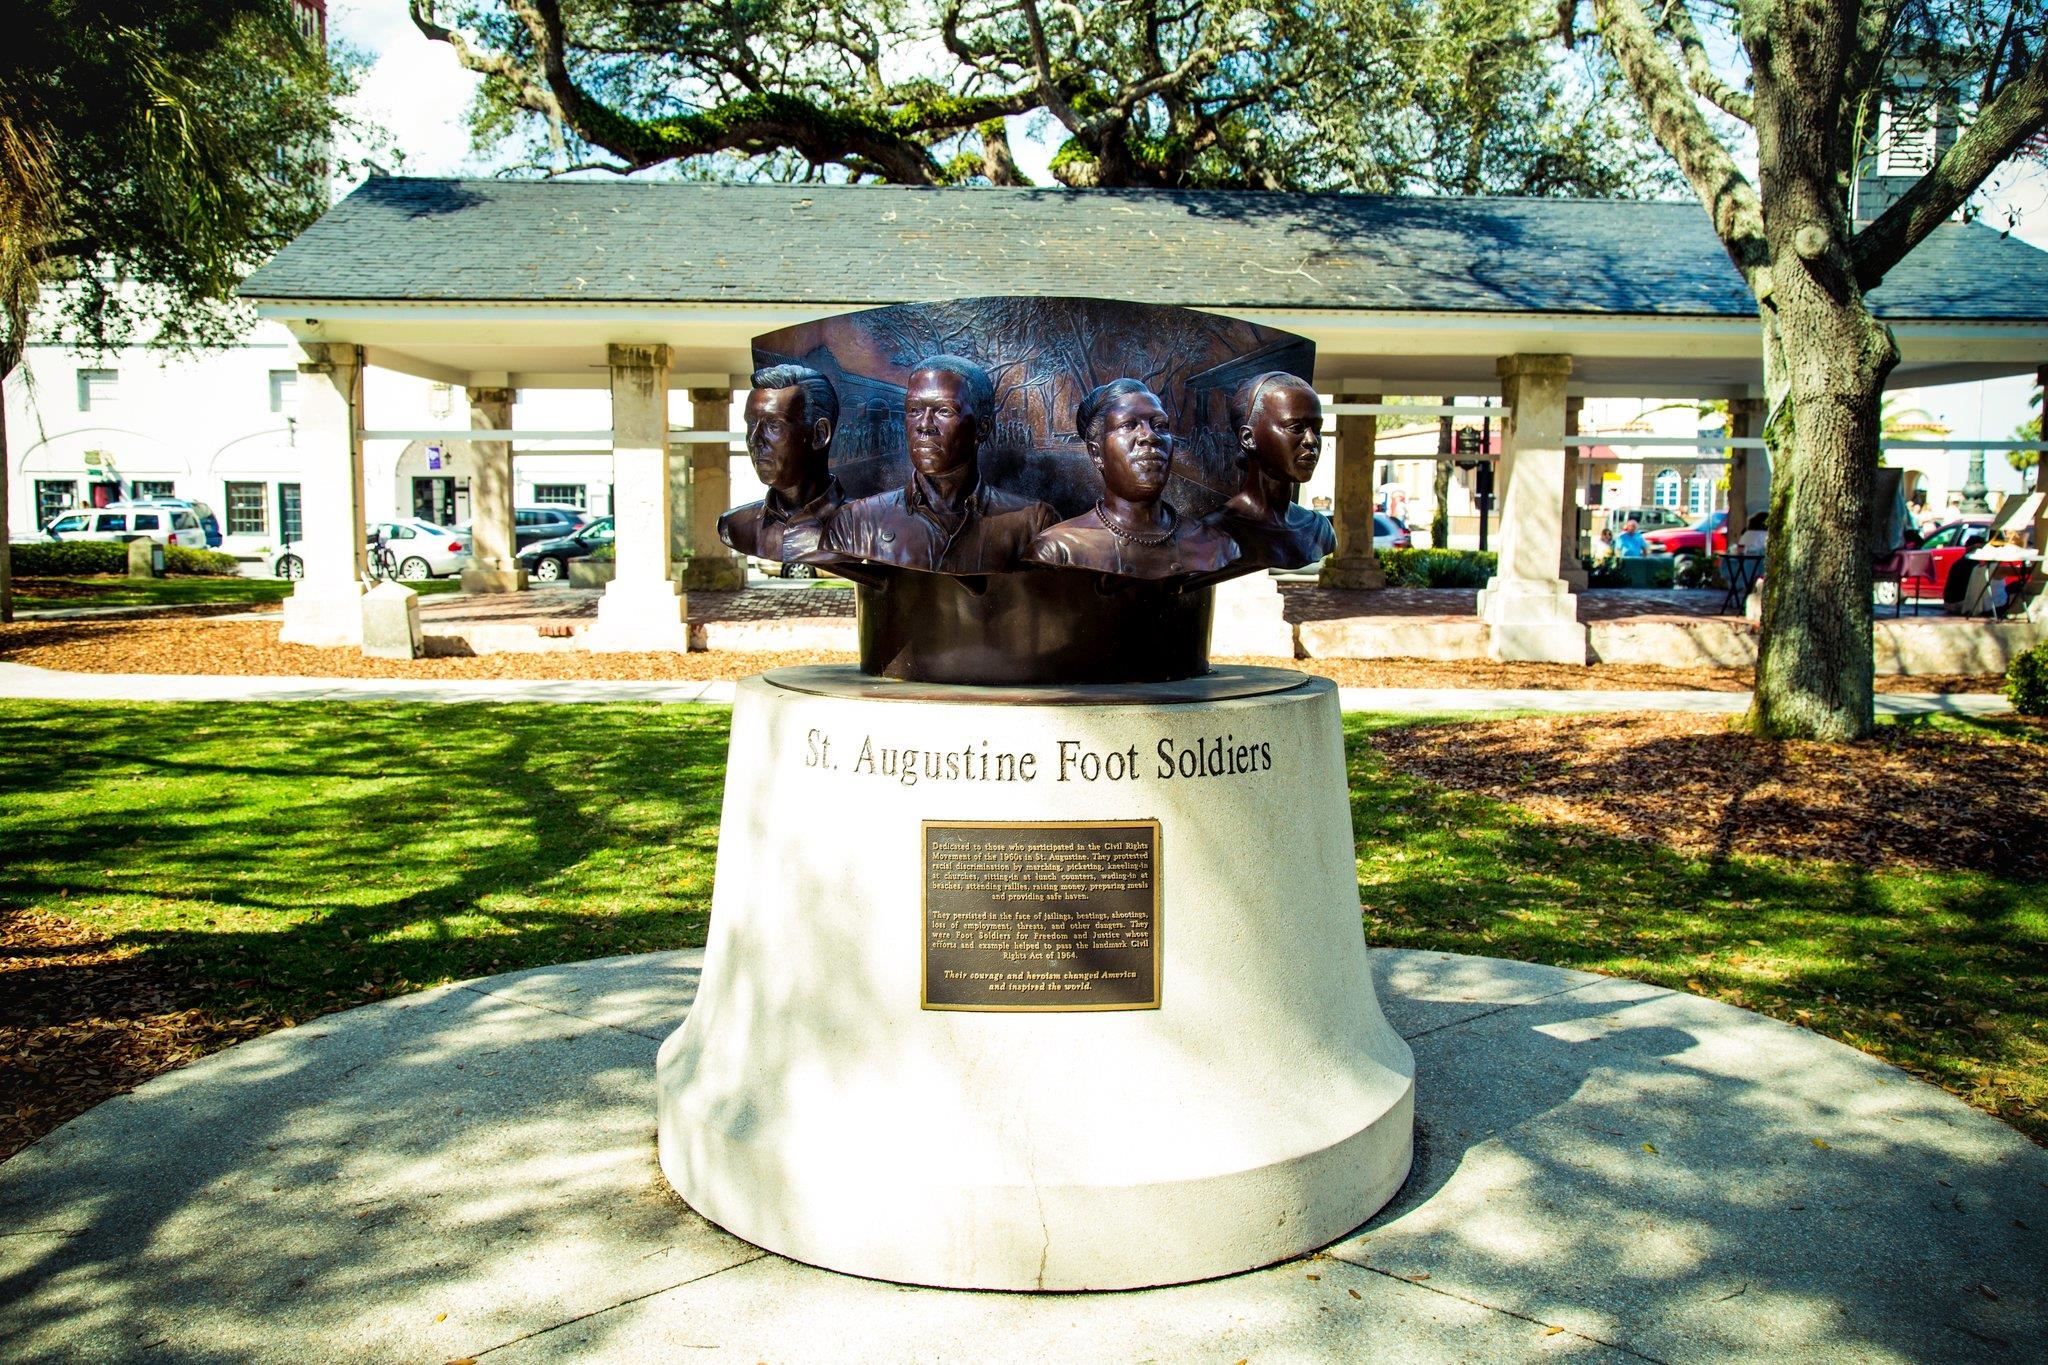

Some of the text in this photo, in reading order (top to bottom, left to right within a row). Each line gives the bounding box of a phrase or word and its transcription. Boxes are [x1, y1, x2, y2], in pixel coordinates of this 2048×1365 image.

[805, 728, 1272, 784] St. Augustine Foot Soldiers
[932, 842, 970, 851] Dedicated
[985, 843, 1005, 851] those
[1009, 843, 1025, 851] who
[1028, 843, 1074, 852] participated
[1125, 842, 1149, 851] Rights
[932, 852, 972, 861] Movement
[974, 853, 983, 861] of
[984, 853, 997, 861] the
[1000, 853, 1023, 861] 1960s
[1035, 853, 1046, 861] St.
[1049, 853, 1089, 862] Augustine.
[1092, 853, 1111, 861] They
[1114, 852, 1149, 861] protested
[932, 862, 1148, 872] racial discrimination by marching, picketing, kneeling-in
[944, 872, 980, 881] churches,
[984, 873, 1019, 882] sitting-in
[1101, 872, 1137, 881] wading-in
[932, 882, 963, 891] beaches,
[966, 882, 1002, 891] attending
[1033, 883, 1059, 891] raising
[1090, 882, 1126, 891] preparing
[1127, 881, 1149, 889] meals
[1008, 893, 1045, 901] providing
[932, 911, 950, 920] They
[953, 912, 987, 921] persisted
[1000, 912, 1012, 920] the
[1015, 912, 1031, 920] face
[1034, 912, 1042, 920] of
[1044, 912, 1074, 921] jailings,
[1112, 911, 1149, 919] shootings,
[932, 921, 946, 929] loss
[964, 922, 1013, 931] employment,
[1017, 922, 1047, 930] threats,
[1052, 922, 1066, 930] and
[1095, 922, 1126, 930] dangers.
[1130, 921, 1149, 929] They
[979, 932, 1011, 940] Soldiers
[1034, 932, 1068, 940] Freedom
[1093, 931, 1120, 939] Justice
[1125, 930, 1149, 938] whose
[961, 941, 975, 949] and
[979, 942, 1010, 950] example
[1014, 942, 1040, 950] helped
[1093, 941, 1127, 949] landmark
[1003, 952, 1027, 961] Rights
[944, 970, 1137, 980] Their courage and heroism changed America
[989, 982, 1092, 992] and inspired the world.
